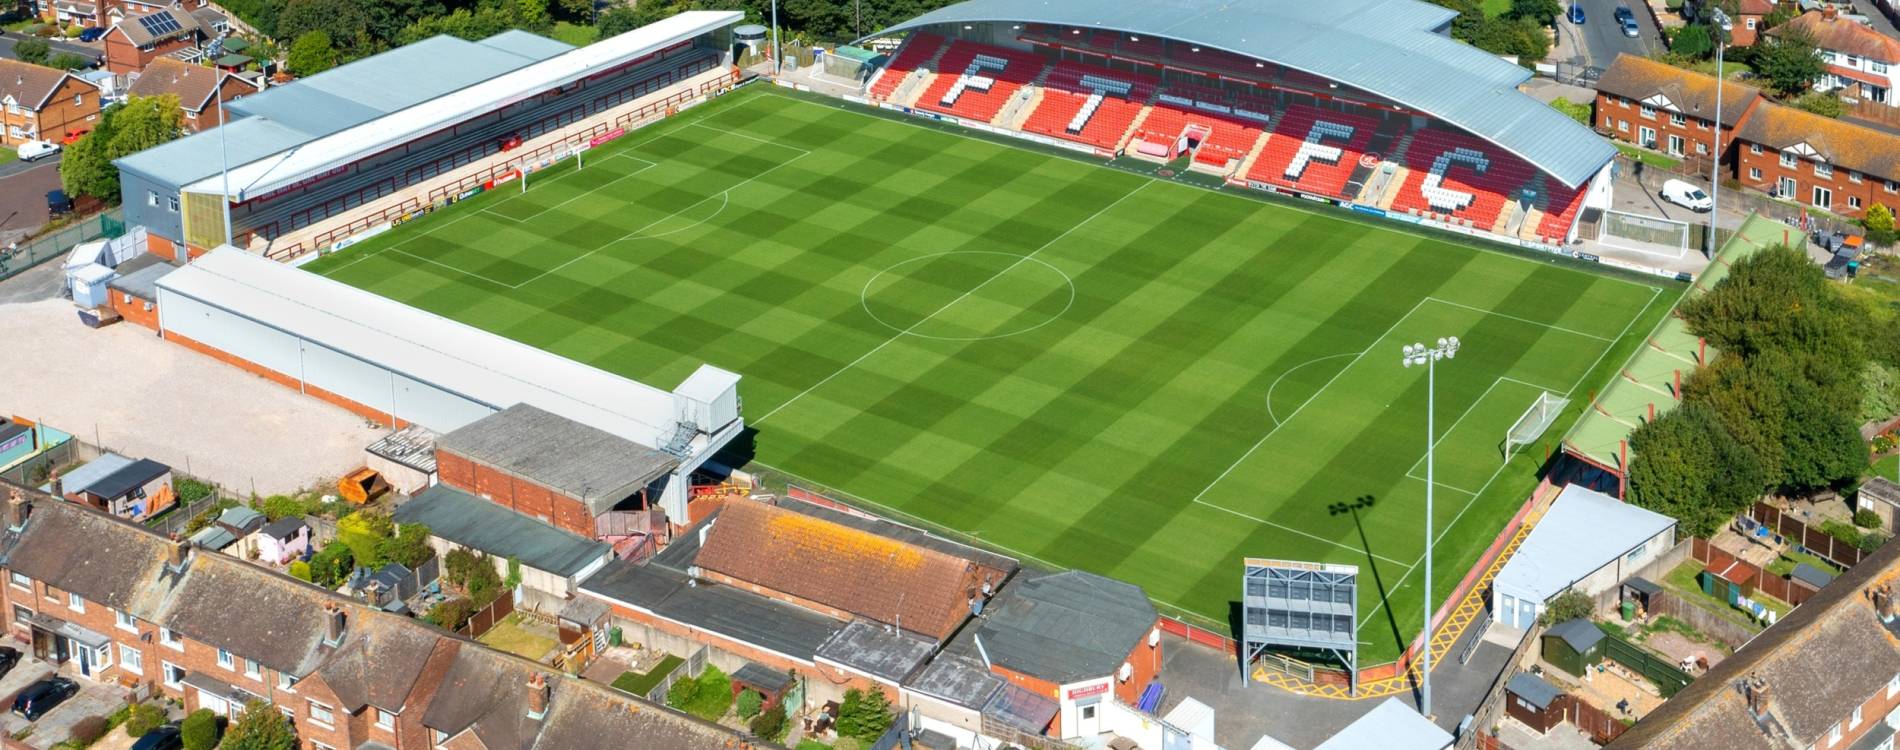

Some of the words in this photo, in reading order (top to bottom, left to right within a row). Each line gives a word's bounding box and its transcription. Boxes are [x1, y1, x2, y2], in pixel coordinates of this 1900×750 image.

[940, 54, 1008, 107] F
[1066, 75, 1132, 134] T
[1284, 120, 1355, 180] F
[1421, 147, 1490, 214] C
